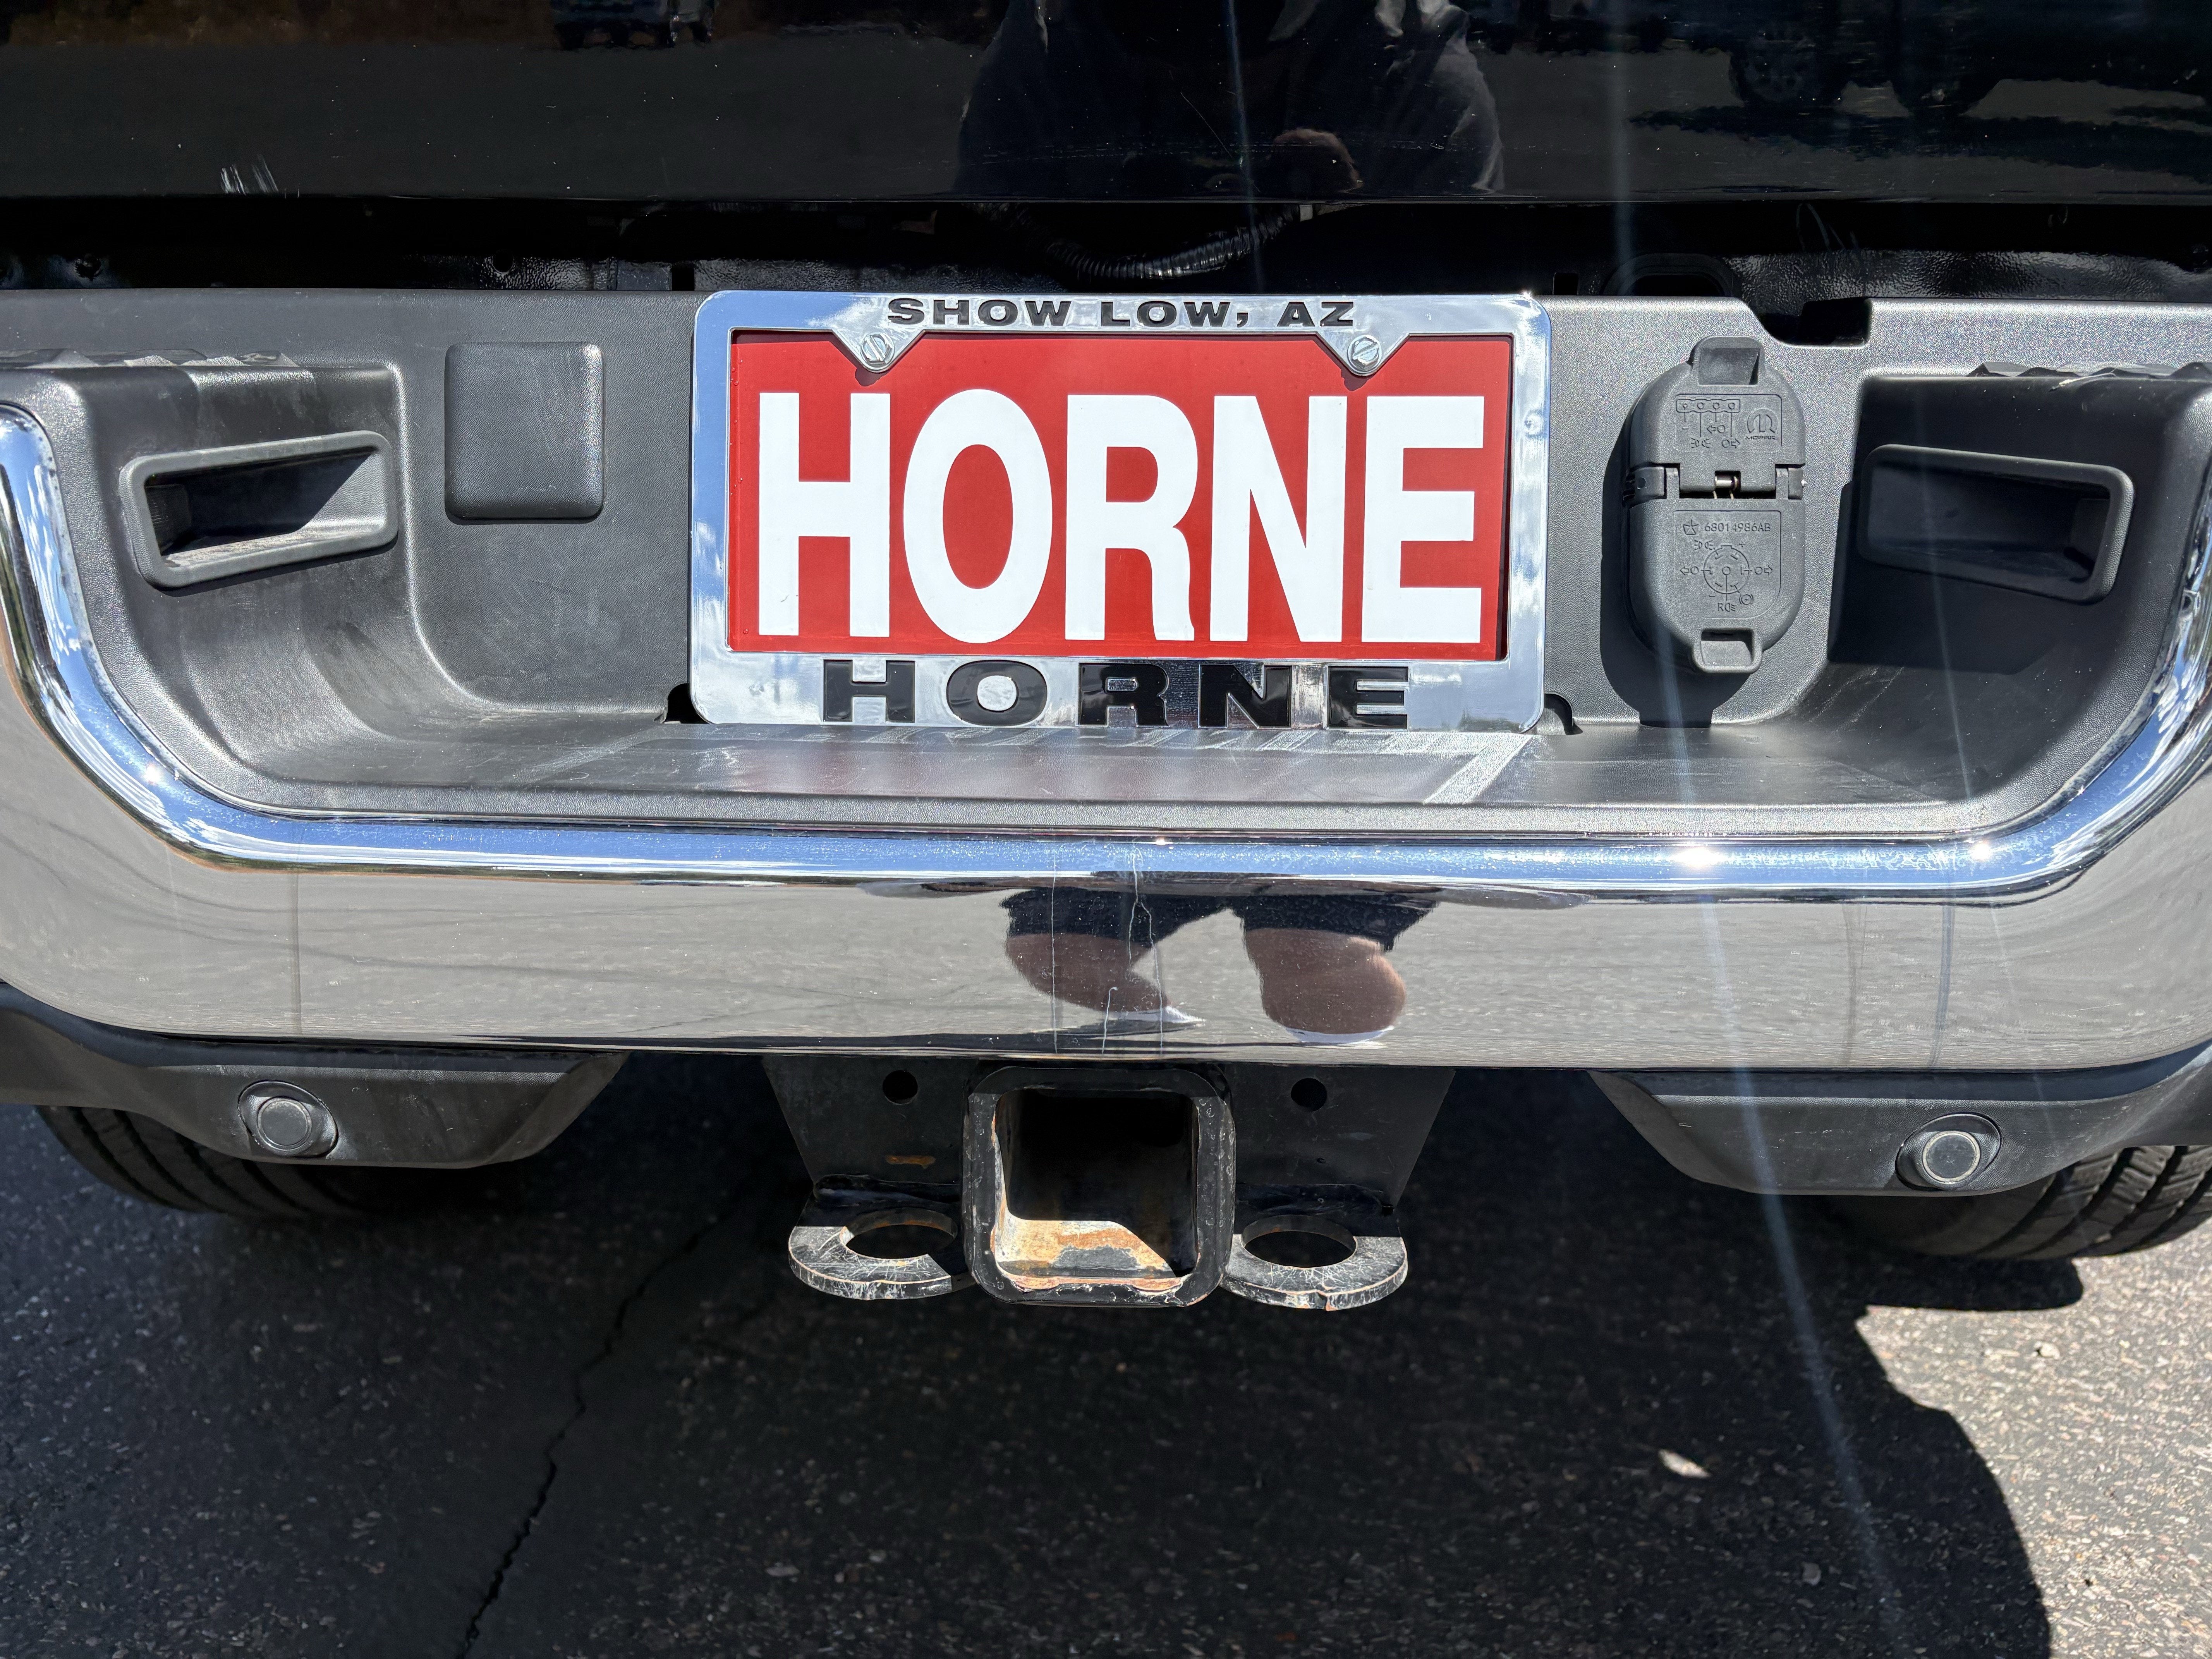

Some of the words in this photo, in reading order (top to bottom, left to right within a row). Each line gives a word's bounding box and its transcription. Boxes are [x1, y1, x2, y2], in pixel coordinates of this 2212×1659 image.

[888, 297, 1070, 327] SHOW
[1101, 299, 1248, 328] LOW,
[1277, 301, 1355, 327] AZ
[758, 389, 1485, 644] HORNE
[1705, 523, 1771, 532] 68014986AB
[823, 659, 1410, 729] HORNE
